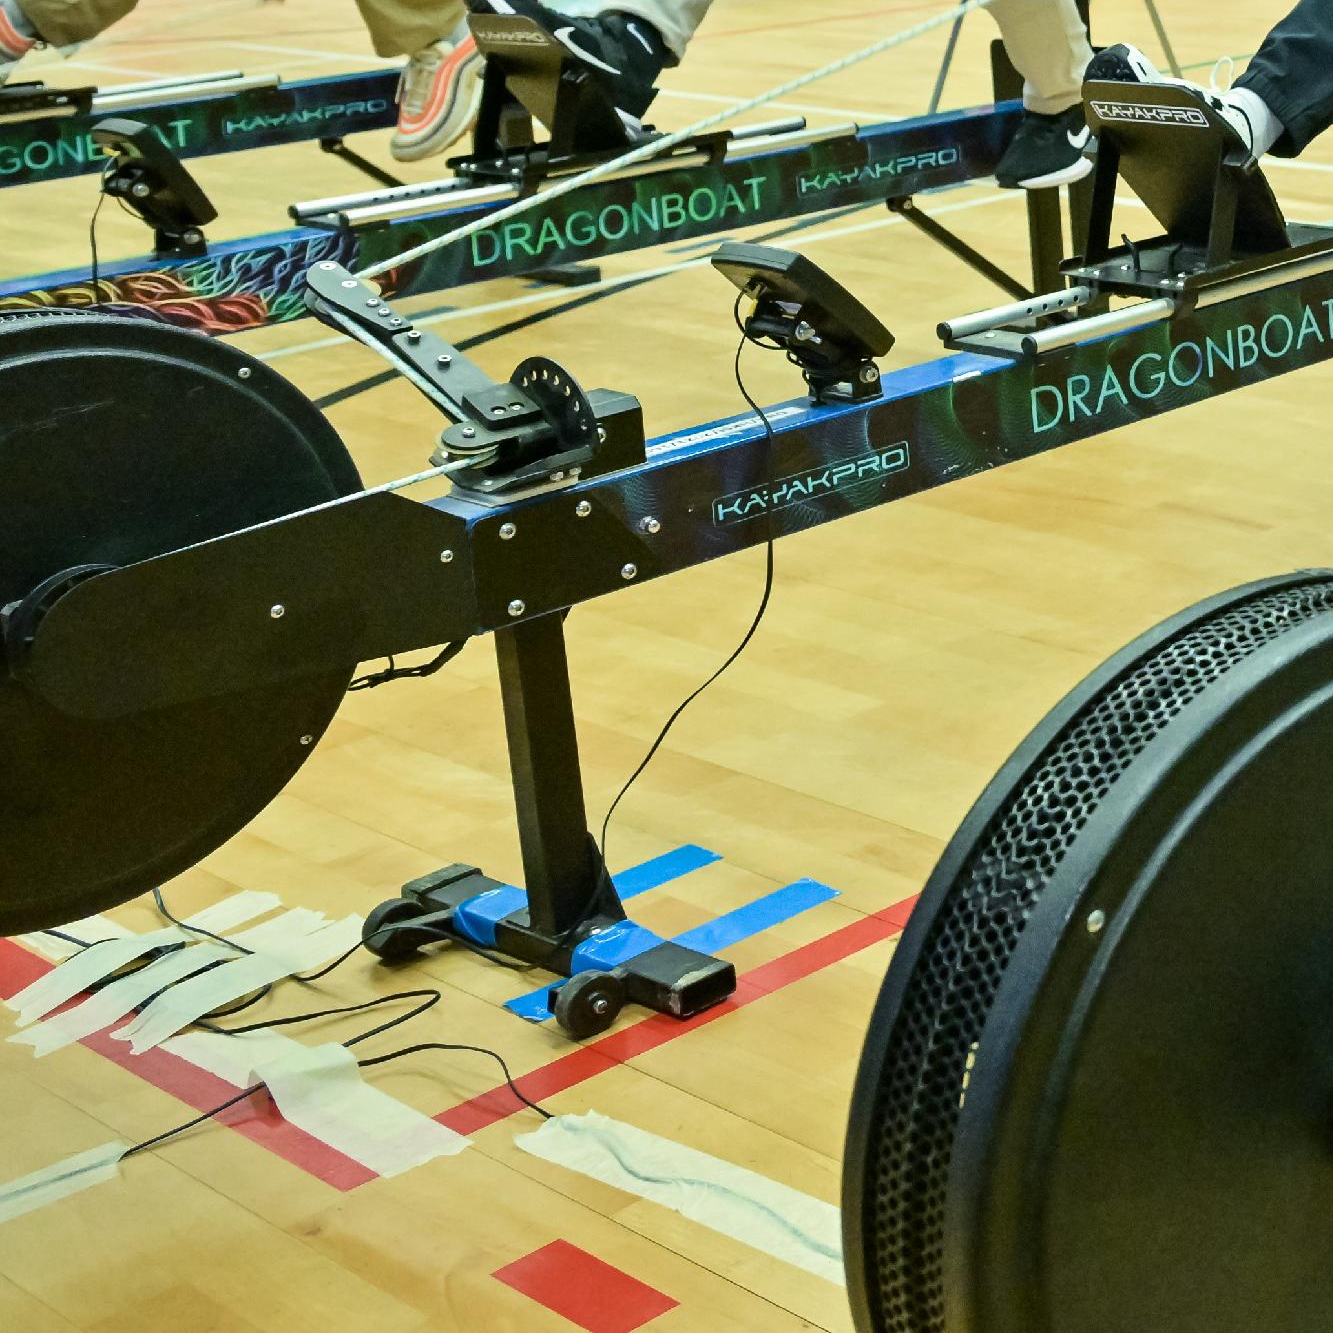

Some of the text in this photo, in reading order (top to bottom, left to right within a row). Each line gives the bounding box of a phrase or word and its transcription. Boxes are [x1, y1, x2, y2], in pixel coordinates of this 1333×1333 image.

[1096, 105, 1204, 123] KAYAKPRO
[471, 147, 958, 267] DRAGONBOAT KAYAKPRO
[716, 447, 906, 523] KAYAKPRO
